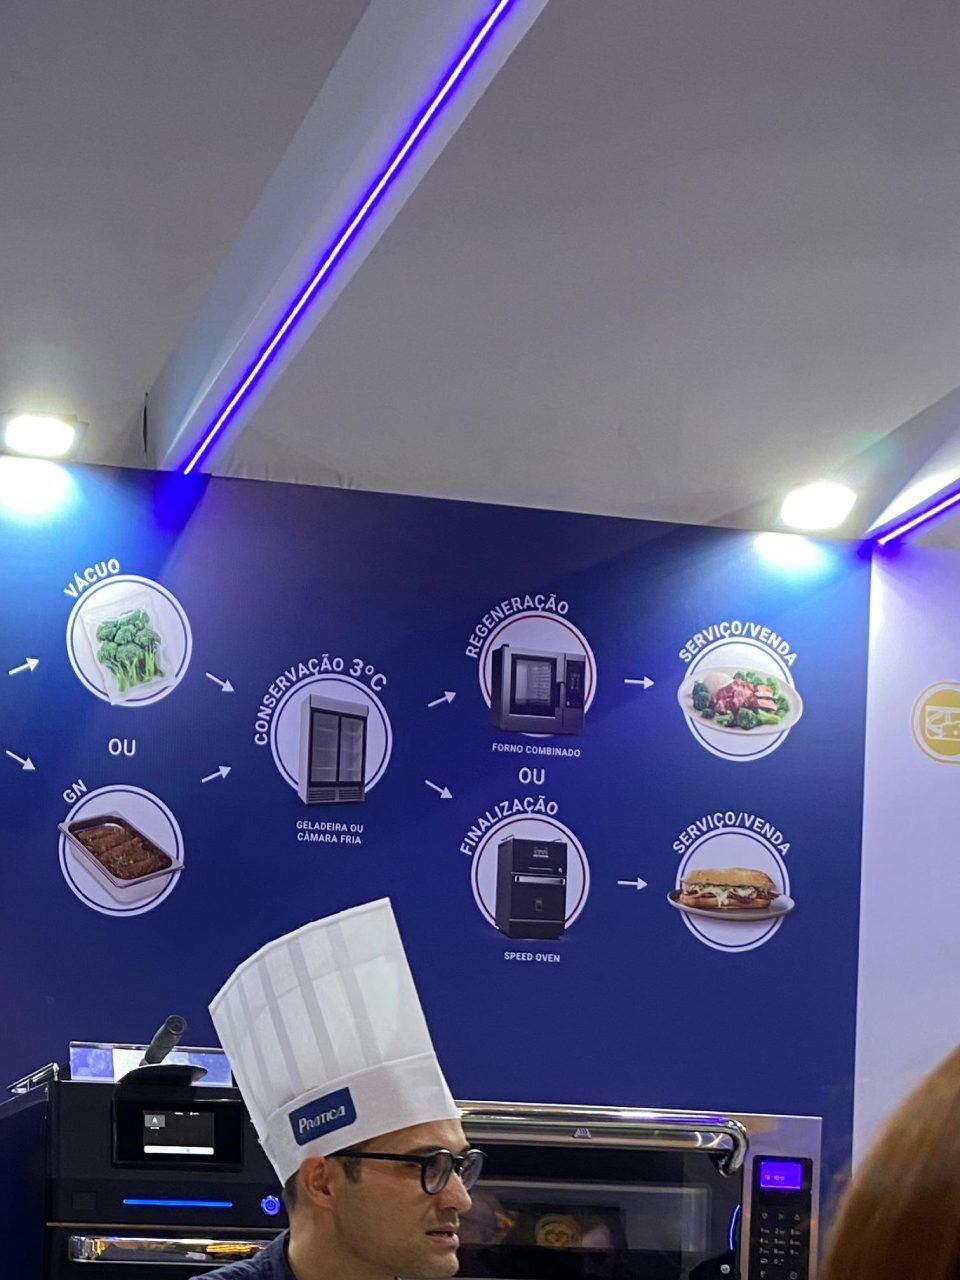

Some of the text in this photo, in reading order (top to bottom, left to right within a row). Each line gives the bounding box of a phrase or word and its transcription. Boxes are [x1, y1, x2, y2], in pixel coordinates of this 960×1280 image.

[63, 558, 121, 600] VÁCUO
[465, 594, 569, 659] REGENERAÇÃO
[678, 620, 798, 668] SERVIÇO/VENDA
[254, 653, 345, 746] CONSERVAÇÃO
[108, 737, 137, 757] OU
[492, 743, 581, 758] FORNO COMBINADO
[518, 766, 546, 786] OU
[62, 779, 88, 804] GN
[296, 820, 364, 833] GELADEIRA OU
[297, 831, 362, 844] CÂMARA FRIA
[460, 795, 559, 856] FINALIZAÇÃO
[672, 811, 791, 857] SERVIÇO/VENDA
[504, 951, 560, 963] SPEED OVEN
